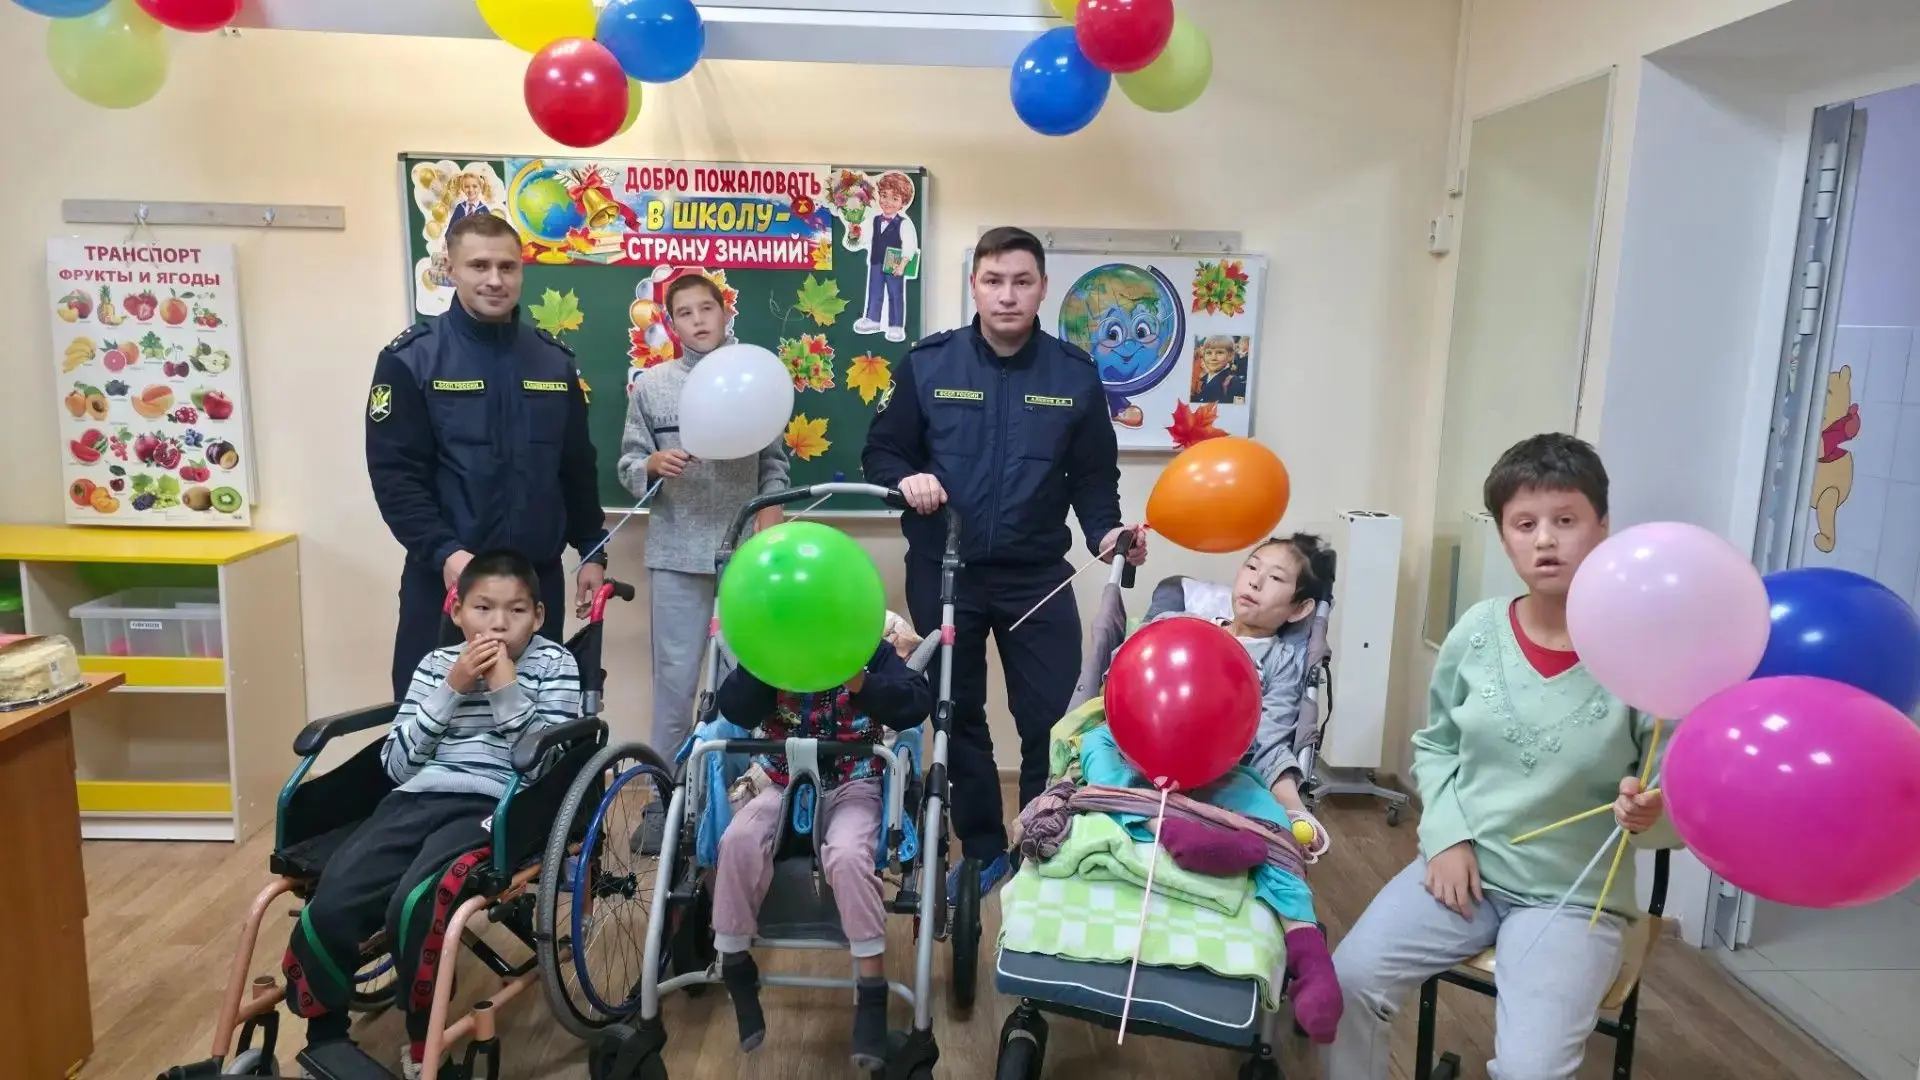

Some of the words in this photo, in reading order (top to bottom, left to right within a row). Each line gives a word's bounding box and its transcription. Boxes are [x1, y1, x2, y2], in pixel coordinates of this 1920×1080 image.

[625, 167, 689, 194] ДОБРО
[694, 168, 823, 197] ПОЖАЛОВАТЬ
[646, 200, 666, 232] В
[672, 201, 792, 233] ШКОЛУ-
[84, 245, 202, 264] ТРАНСПОРТ
[627, 236, 711, 263] СТРАНУ
[714, 232, 810, 264] ЗНАНИЙ!
[58, 268, 133, 283] ФРУКТЫ
[138, 271, 151, 283] И
[156, 271, 221, 287] ЯГОДЫ
